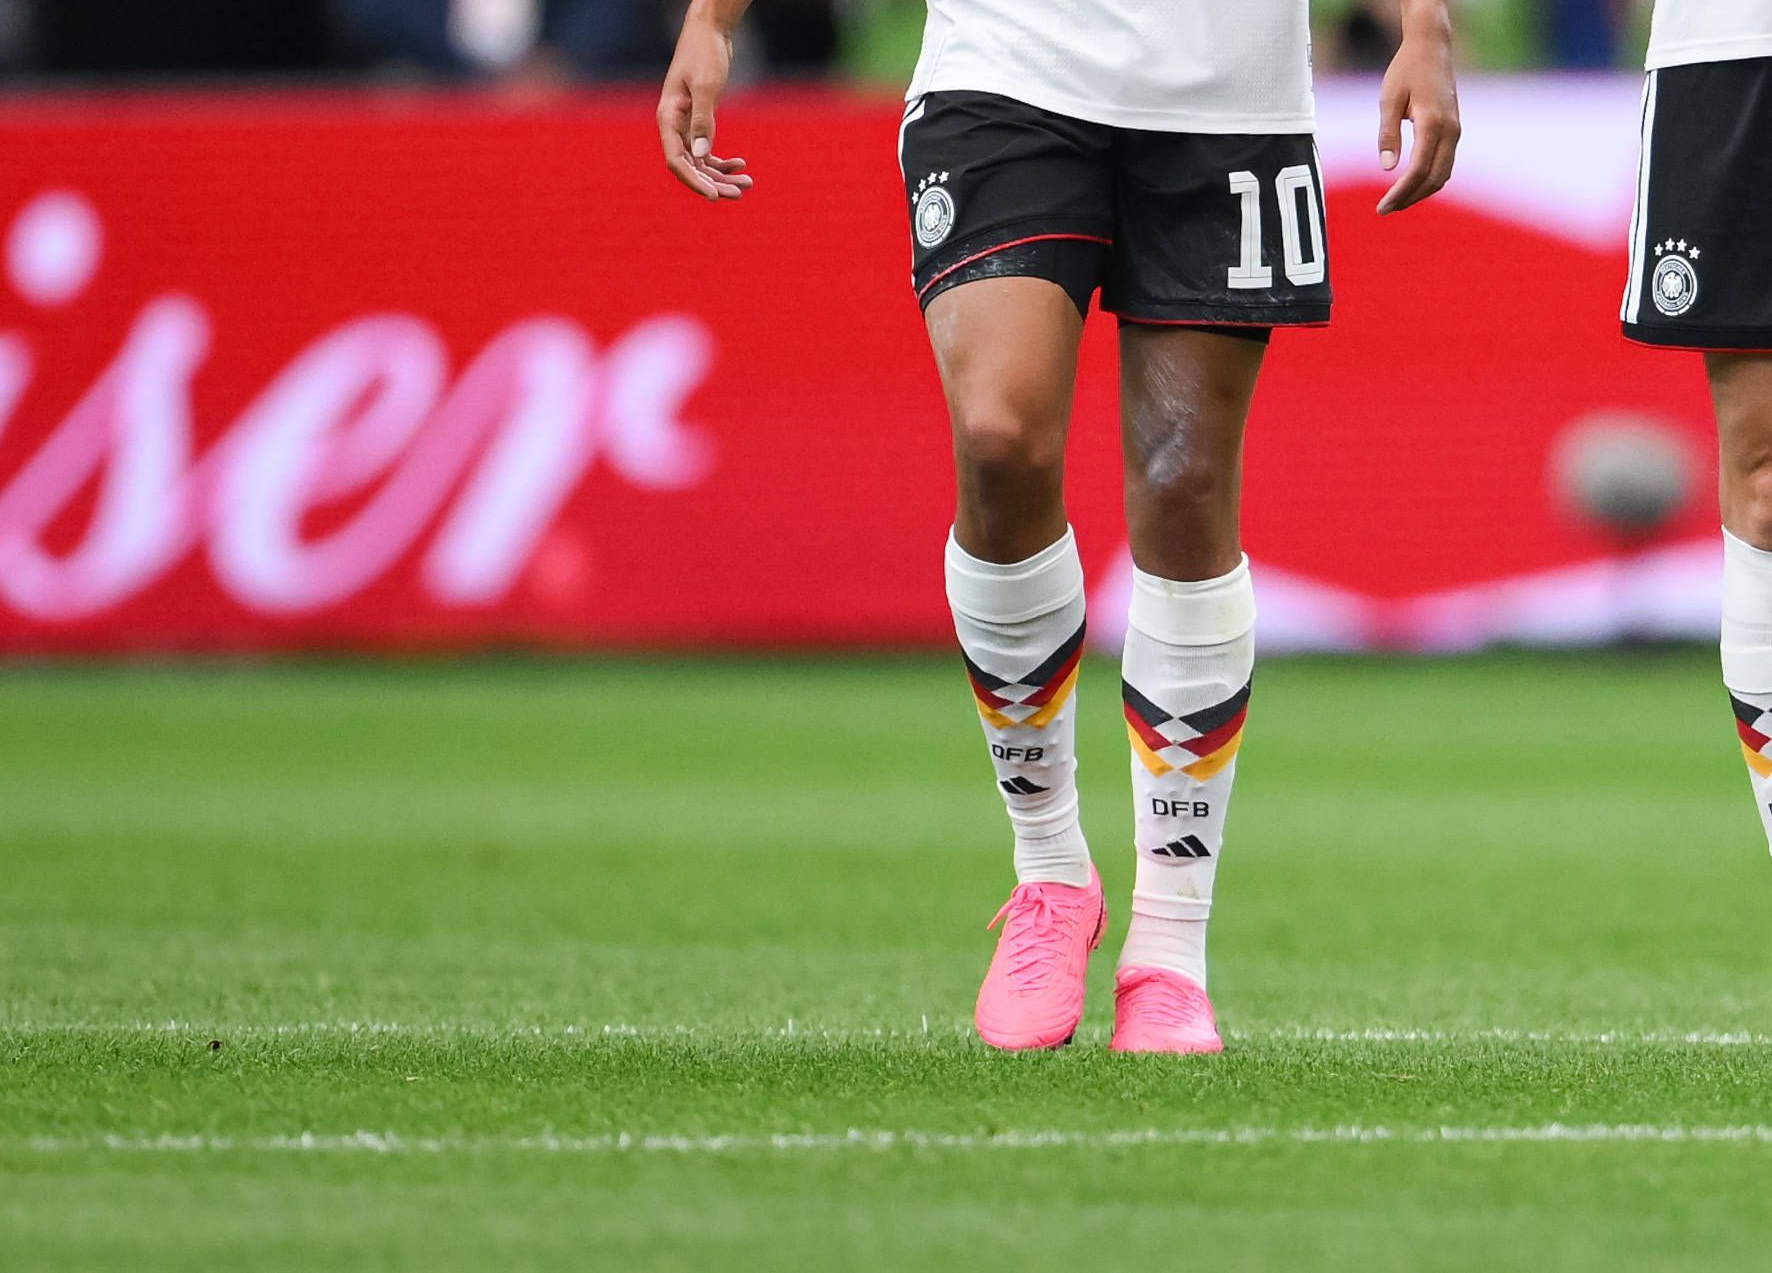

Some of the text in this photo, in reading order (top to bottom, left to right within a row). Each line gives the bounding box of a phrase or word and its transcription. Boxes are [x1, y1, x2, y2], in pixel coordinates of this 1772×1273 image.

[1227, 164, 1326, 289] 10
[992, 744, 1043, 762] DFB
[1152, 798, 1209, 818] DFB
